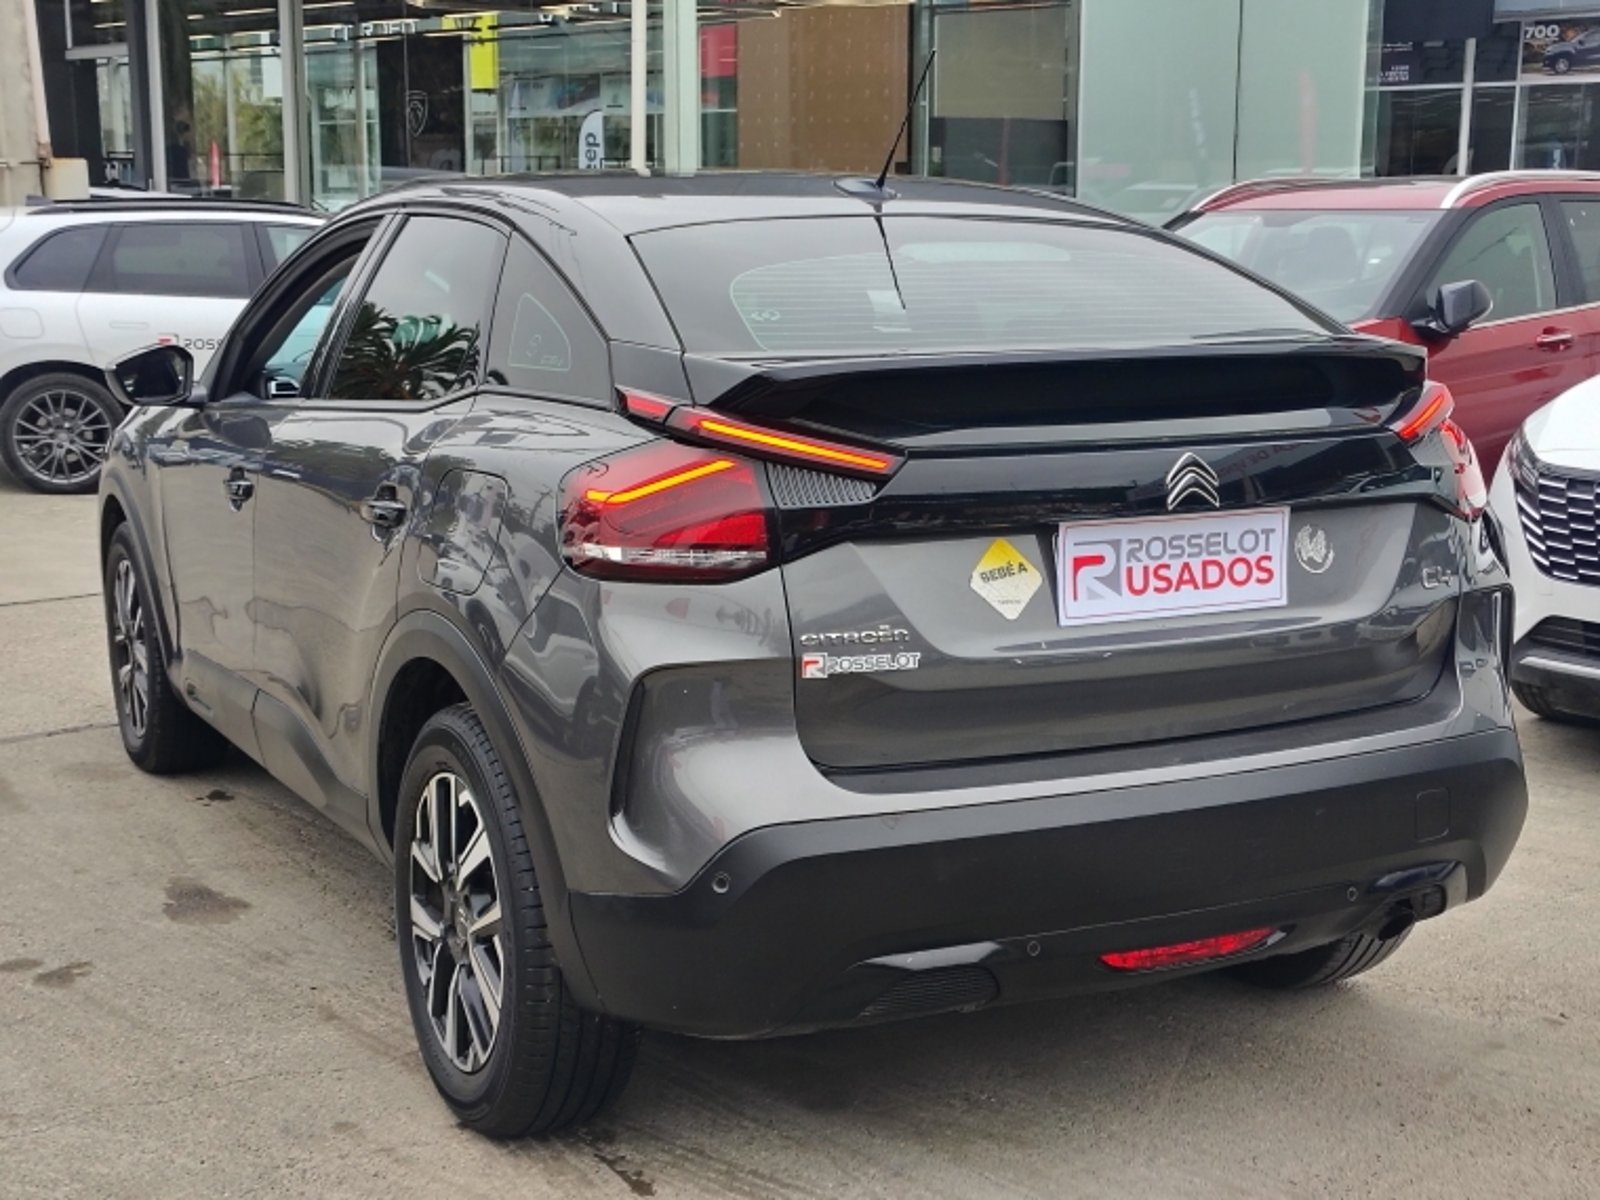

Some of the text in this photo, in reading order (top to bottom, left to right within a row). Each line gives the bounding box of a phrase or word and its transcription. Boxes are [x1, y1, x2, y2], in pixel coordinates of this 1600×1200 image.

[1126, 528, 1276, 563] ROSSELOT
[1126, 555, 1274, 596] USADOS
[827, 653, 920, 673] ROSSELOT
